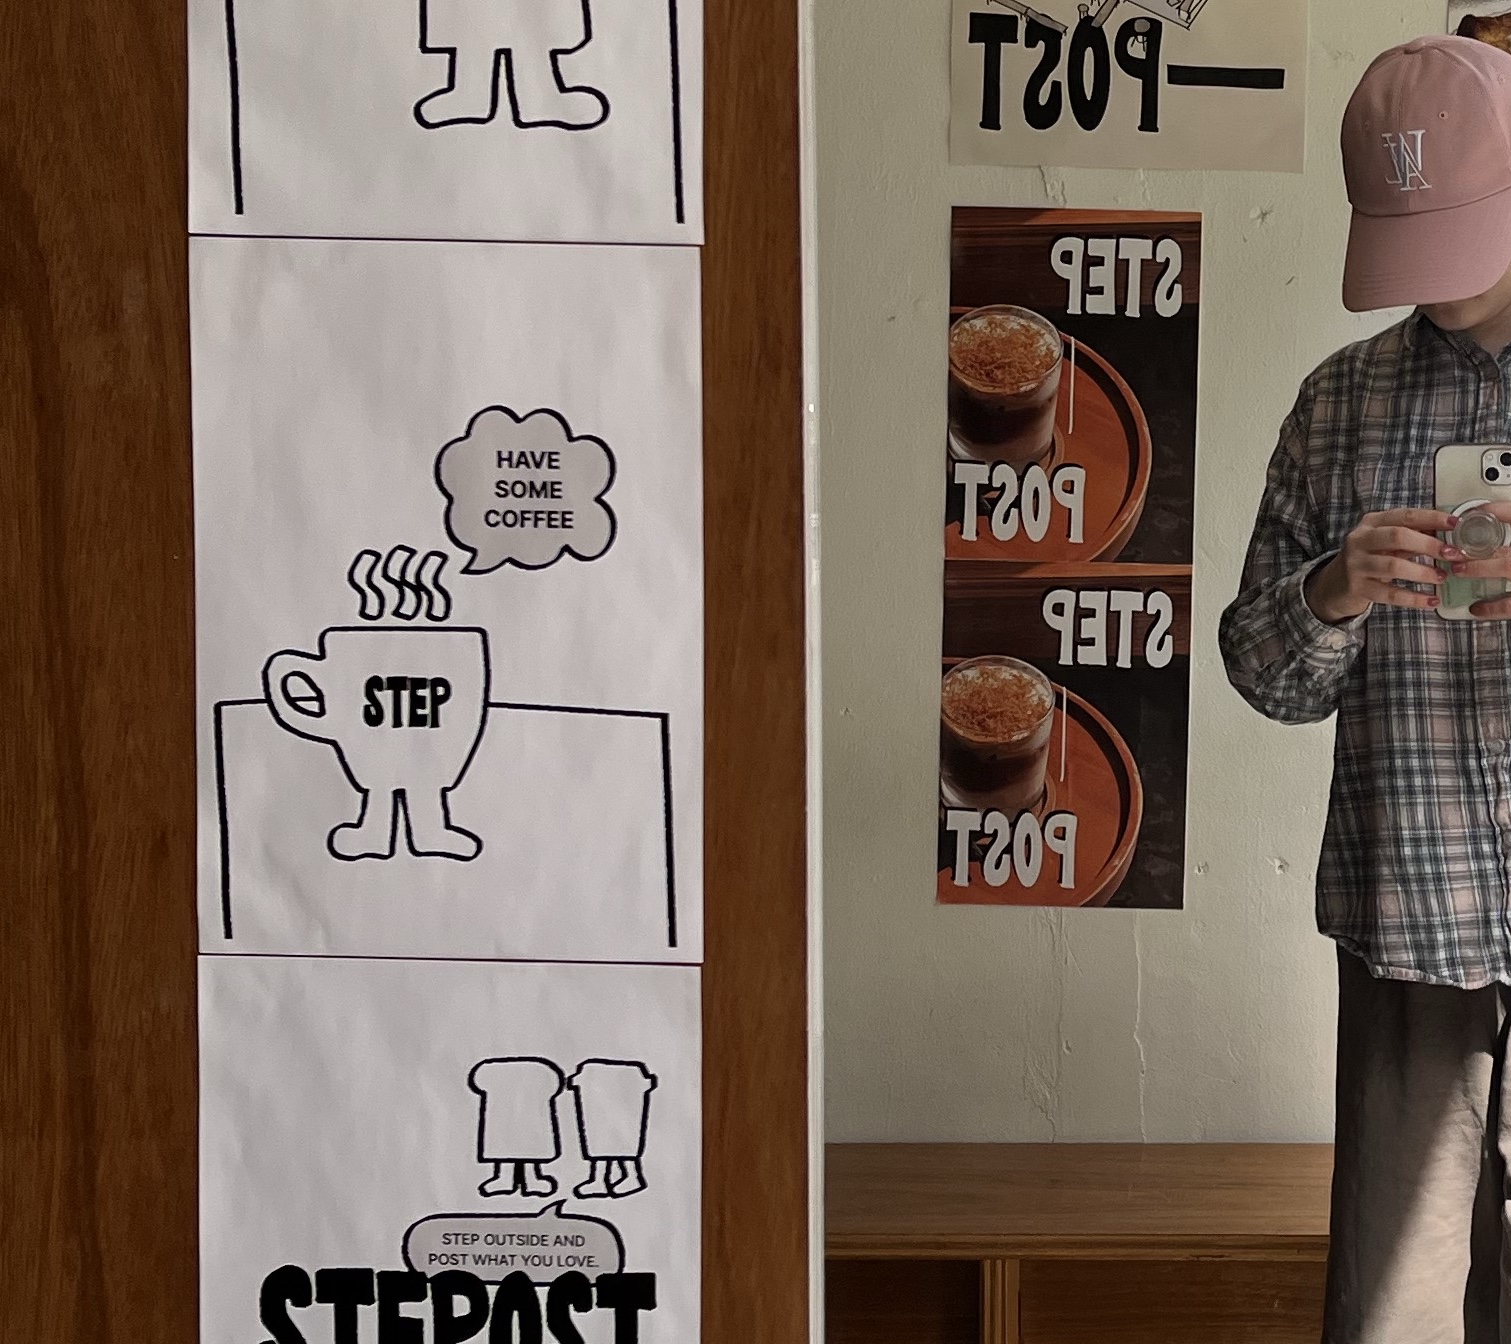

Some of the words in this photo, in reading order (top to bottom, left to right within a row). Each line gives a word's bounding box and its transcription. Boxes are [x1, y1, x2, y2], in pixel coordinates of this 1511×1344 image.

[495, 450, 561, 470] HAVE
[494, 480, 563, 500] SOME
[483, 509, 575, 530] COFFEE
[362, 675, 451, 729] STEP
[441, 1232, 480, 1246] STEP
[483, 1233, 550, 1248] OUTSIDE
[552, 1234, 586, 1248] AND
[427, 1252, 469, 1266] POST
[472, 1253, 517, 1267] WHAT
[519, 1254, 552, 1268] YOU
